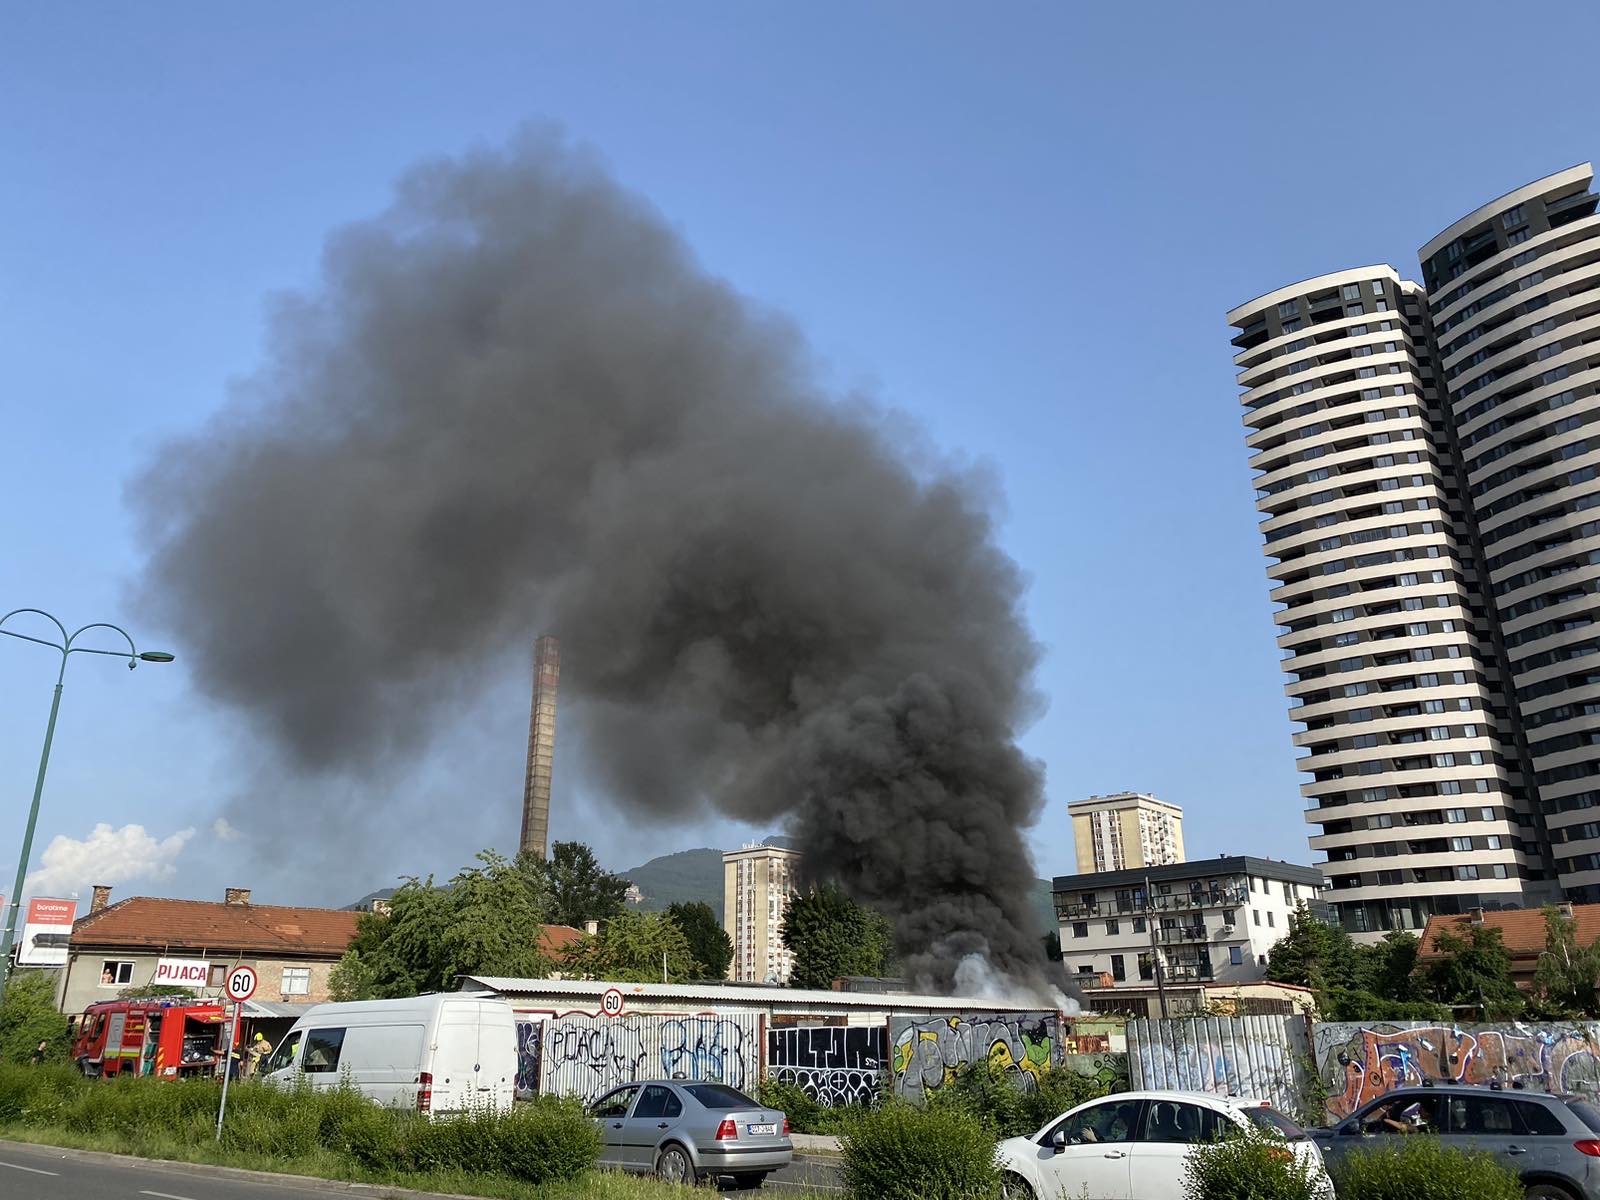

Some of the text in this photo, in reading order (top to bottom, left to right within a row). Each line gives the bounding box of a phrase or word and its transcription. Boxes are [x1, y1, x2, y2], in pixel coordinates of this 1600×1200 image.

[157, 964, 206, 981] PIJACA
[232, 974, 251, 993] 60
[606, 995, 619, 1010] 60
